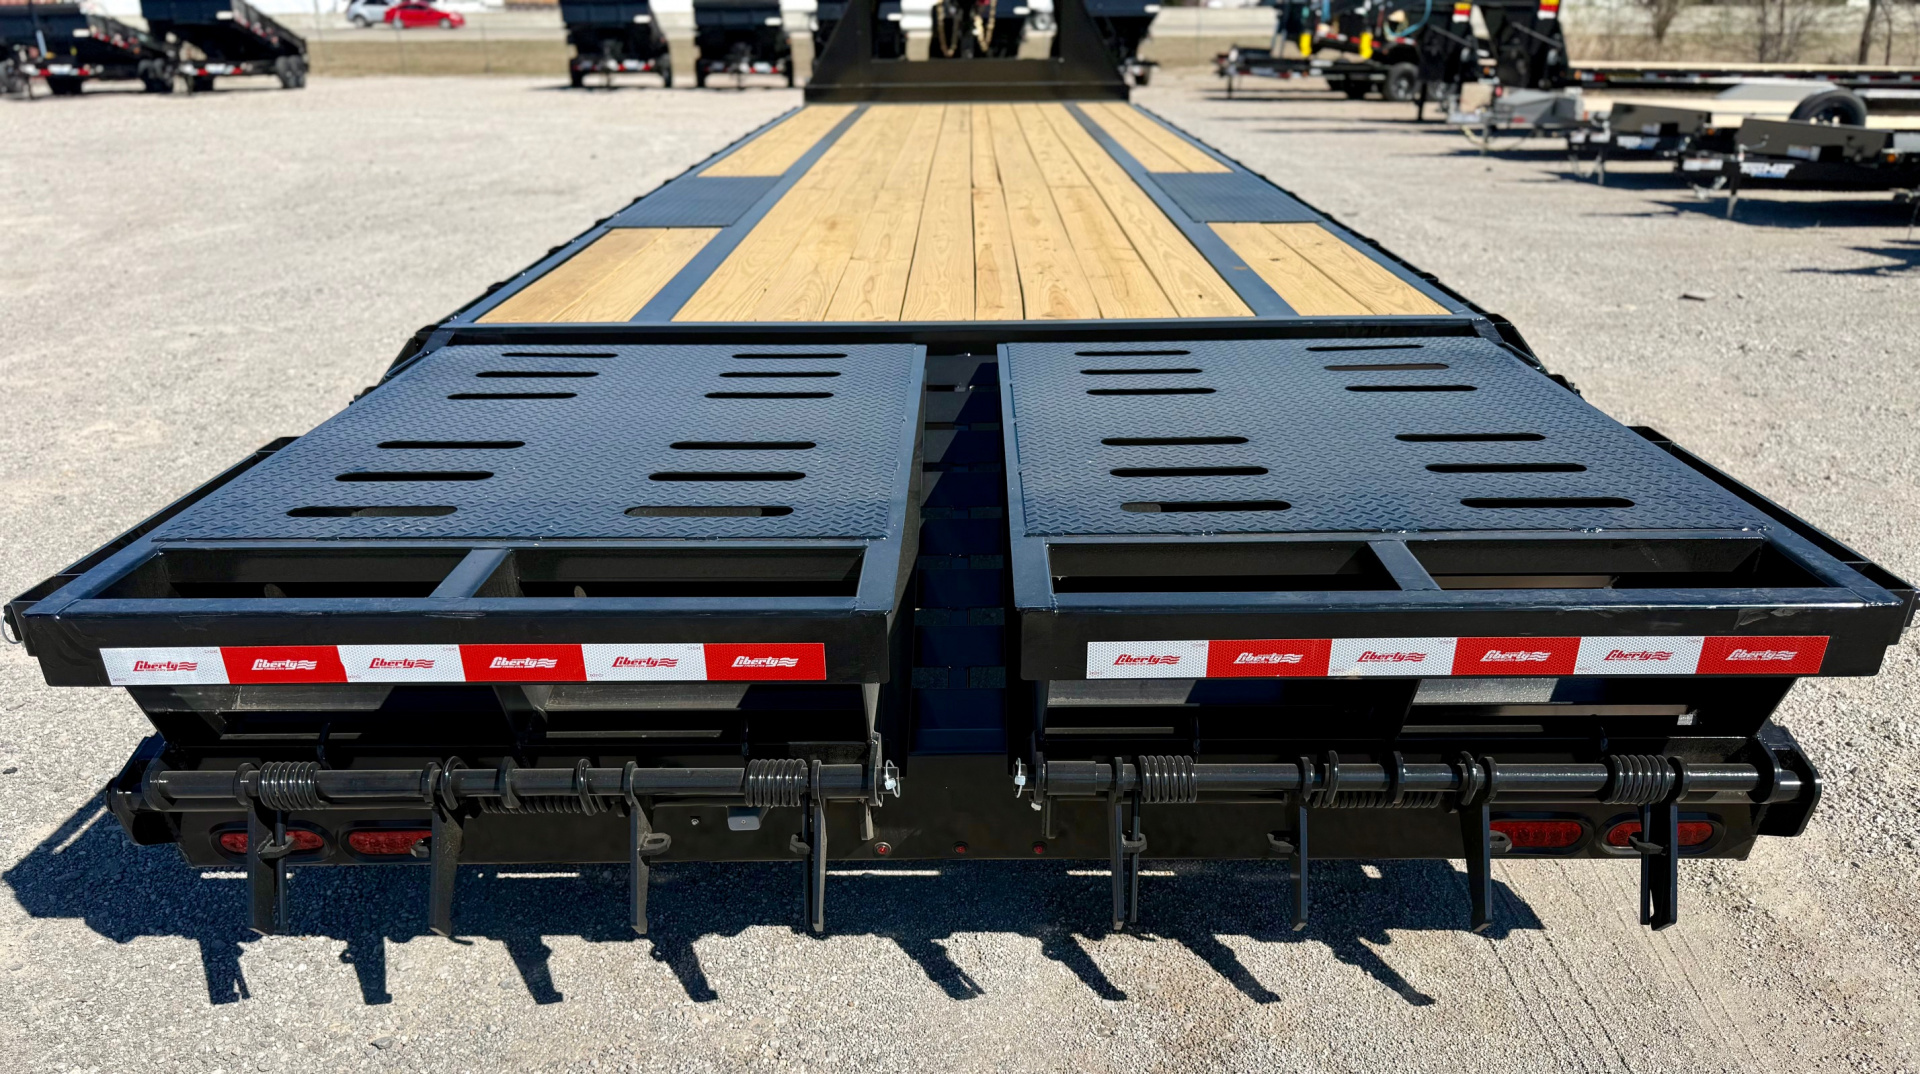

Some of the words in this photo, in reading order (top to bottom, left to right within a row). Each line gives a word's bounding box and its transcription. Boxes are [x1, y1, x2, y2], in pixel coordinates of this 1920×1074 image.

[1113, 653, 1161, 666] Liberty
[1233, 652, 1283, 664] Liberty
[1357, 650, 1406, 663] Liberty
[1480, 649, 1530, 662] Liberty
[1603, 649, 1653, 661] Liberty
[1725, 648, 1777, 661] Liberty
[133, 660, 179, 672] Liberty
[251, 658, 298, 671] Liberty
[368, 657, 415, 669] Liberty
[489, 656, 537, 669] Liberty
[612, 656, 659, 668] Liberty
[731, 655, 779, 668] Liberty
